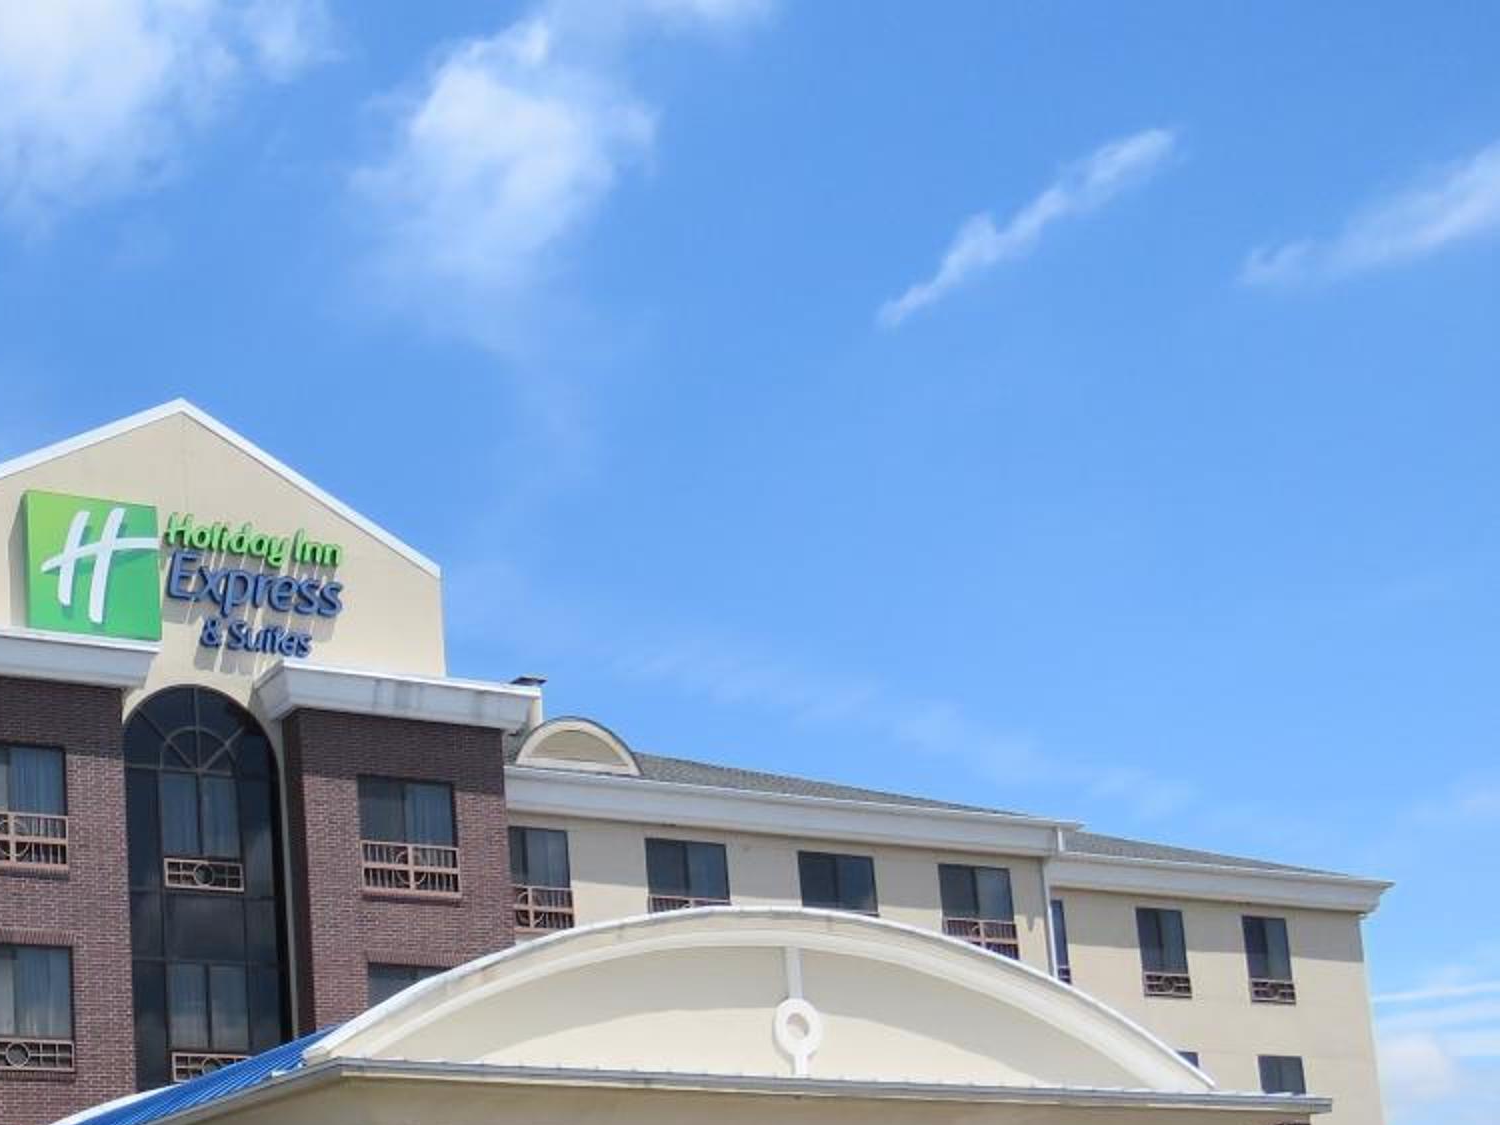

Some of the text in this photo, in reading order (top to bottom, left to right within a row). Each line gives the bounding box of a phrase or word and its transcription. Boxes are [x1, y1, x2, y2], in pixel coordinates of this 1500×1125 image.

[163, 512, 344, 568] Holiday Inn
[167, 551, 344, 619] Express
[201, 617, 313, 657] & Suites
